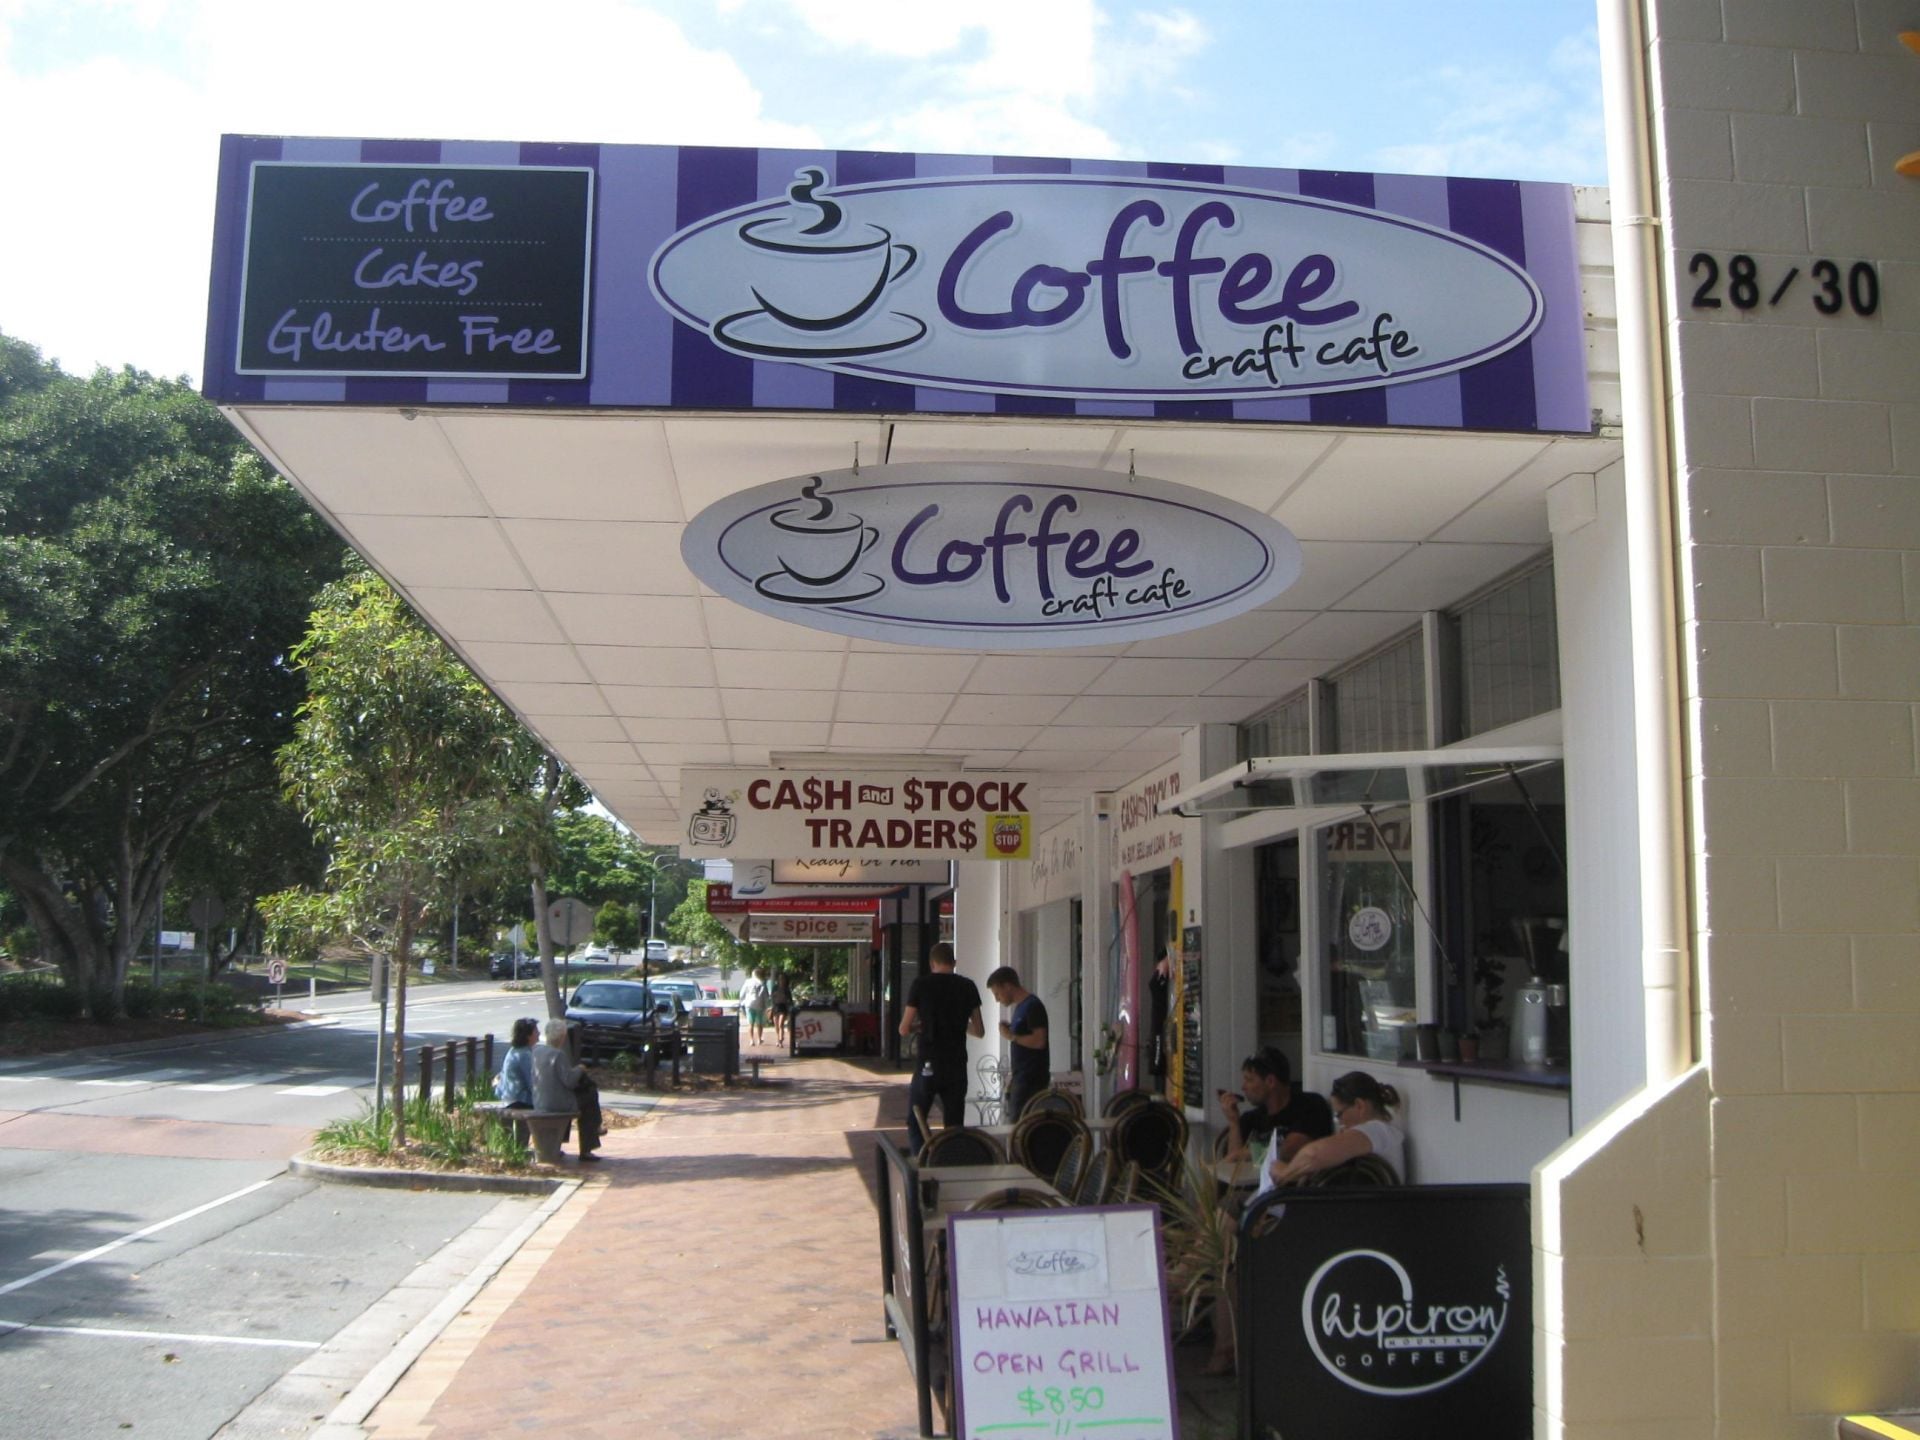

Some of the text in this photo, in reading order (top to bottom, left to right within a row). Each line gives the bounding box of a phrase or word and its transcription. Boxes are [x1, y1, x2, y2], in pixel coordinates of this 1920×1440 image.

[350, 179, 494, 223] Coffee
[355, 249, 482, 295] Cakes
[937, 200, 1358, 359] Coffee
[1688, 253, 1879, 316] 28/30
[267, 308, 561, 361] Gluten Free
[1183, 313, 1417, 384] craft cafe
[891, 494, 1154, 603] Coffee
[1042, 569, 1191, 619] craft cafe
[747, 776, 1028, 813] CA$H and $TOCK
[805, 818, 977, 852] TRADER$
[995, 834, 1020, 845] STOP
[783, 918, 838, 936] spice
[1036, 1251, 1080, 1273] Coffee
[977, 1303, 1120, 1330] HAWAIIAN
[974, 1350, 1140, 1379] OPEN GRILL
[1336, 1351, 1469, 1367] COFFEE
